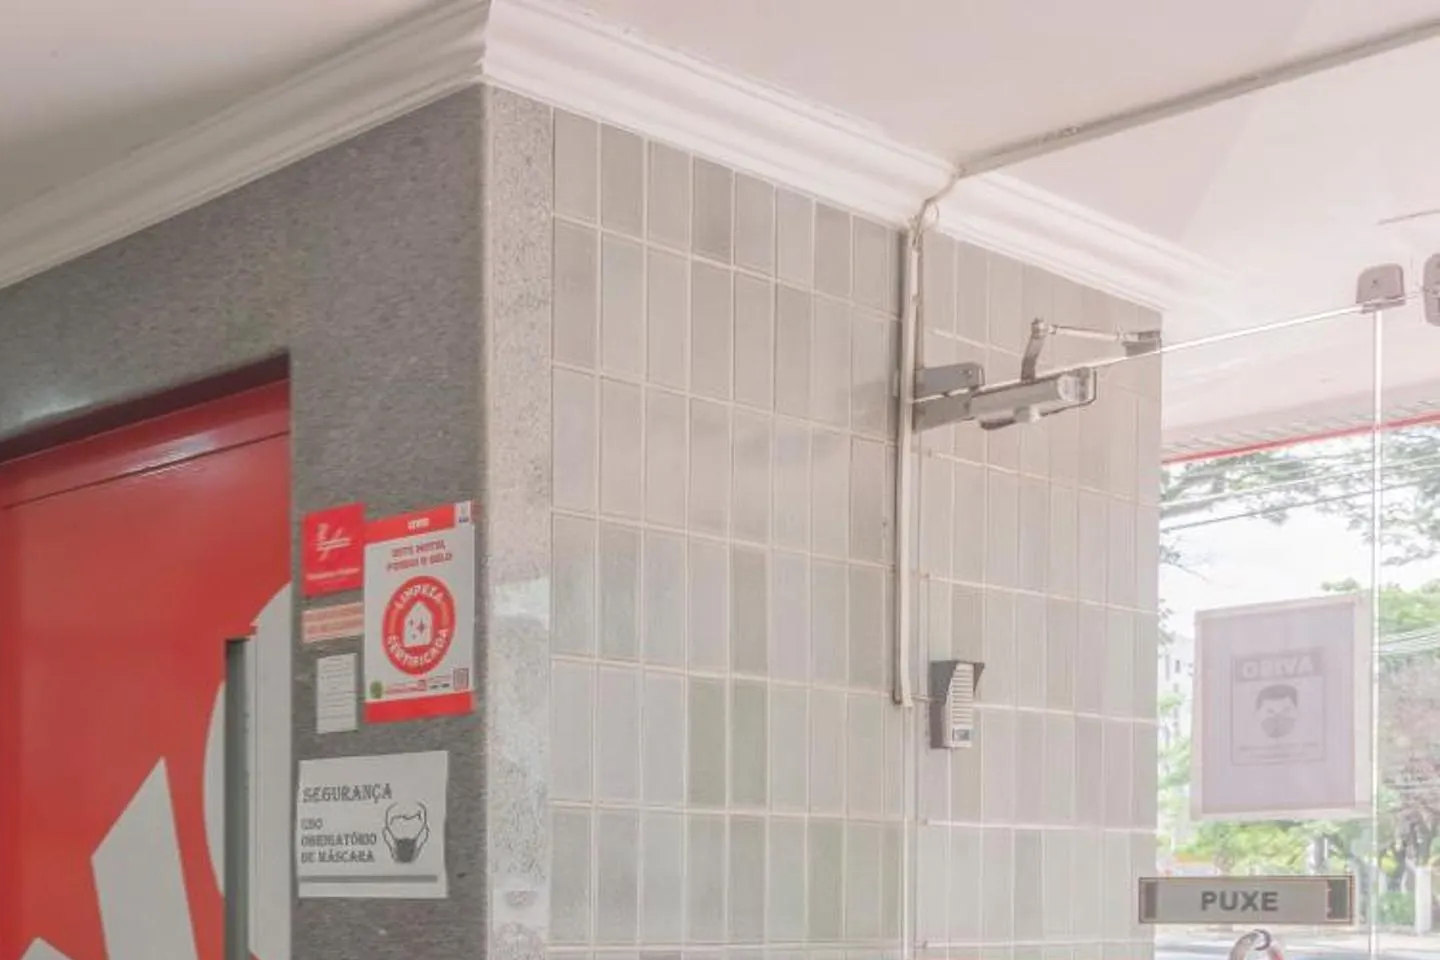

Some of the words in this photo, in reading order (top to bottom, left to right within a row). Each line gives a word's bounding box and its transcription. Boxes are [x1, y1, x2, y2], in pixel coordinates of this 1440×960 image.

[392, 583, 445, 610] LIMPEZA
[386, 628, 450, 669] CERTIFICADA
[302, 783, 393, 804] SEGURANÇA
[318, 848, 376, 864] MÁSCARA
[1200, 890, 1279, 912] PUXE
